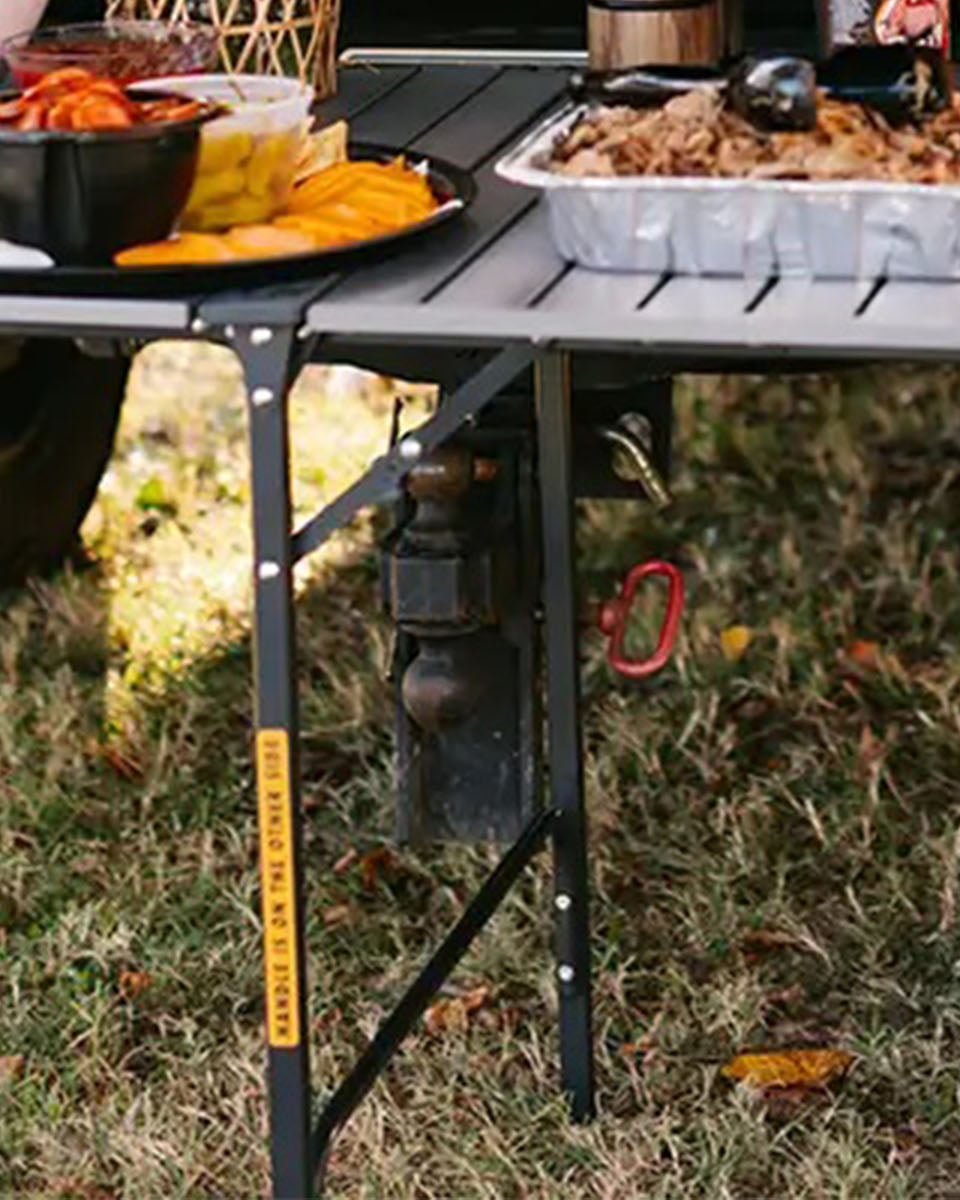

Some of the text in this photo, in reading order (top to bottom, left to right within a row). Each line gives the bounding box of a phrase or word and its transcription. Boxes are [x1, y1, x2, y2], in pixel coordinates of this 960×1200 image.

[263, 739, 280, 780] SIDE
[267, 791, 283, 850] OTHER
[269, 860, 285, 893] THE
[271, 902, 287, 928] ON
[273, 963, 290, 1038] HANDLE
